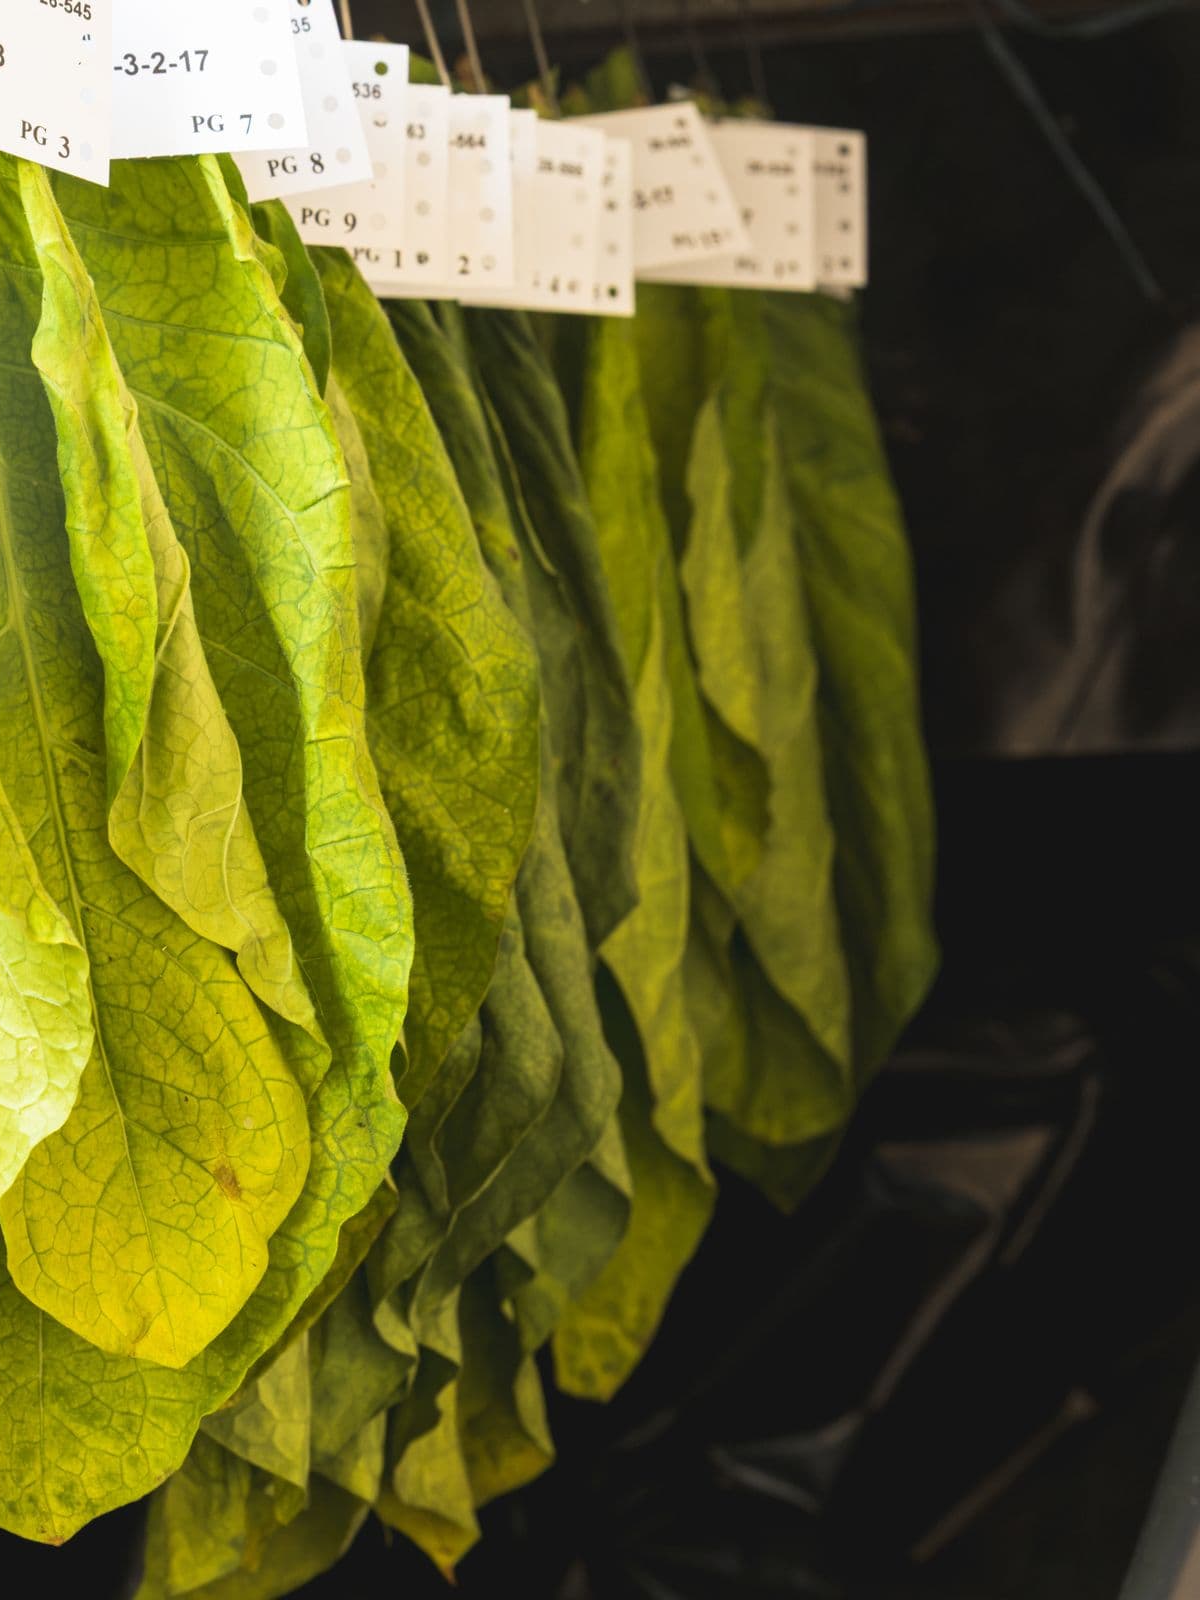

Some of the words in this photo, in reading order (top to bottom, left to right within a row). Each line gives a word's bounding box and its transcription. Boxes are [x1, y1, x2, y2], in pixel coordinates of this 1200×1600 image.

[290, 17, 311, 34] 35
[113, 50, 209, 76] -3-2-17
[191, 114, 224, 133] PG
[240, 114, 252, 134] 7
[20, 120, 47, 146] PG
[58, 136, 70, 158] 3
[267, 156, 297, 177] PG
[310, 152, 324, 174] 8
[301, 208, 329, 227] PG
[343, 212, 357, 233] 9
[458, 255, 471, 276] 2
